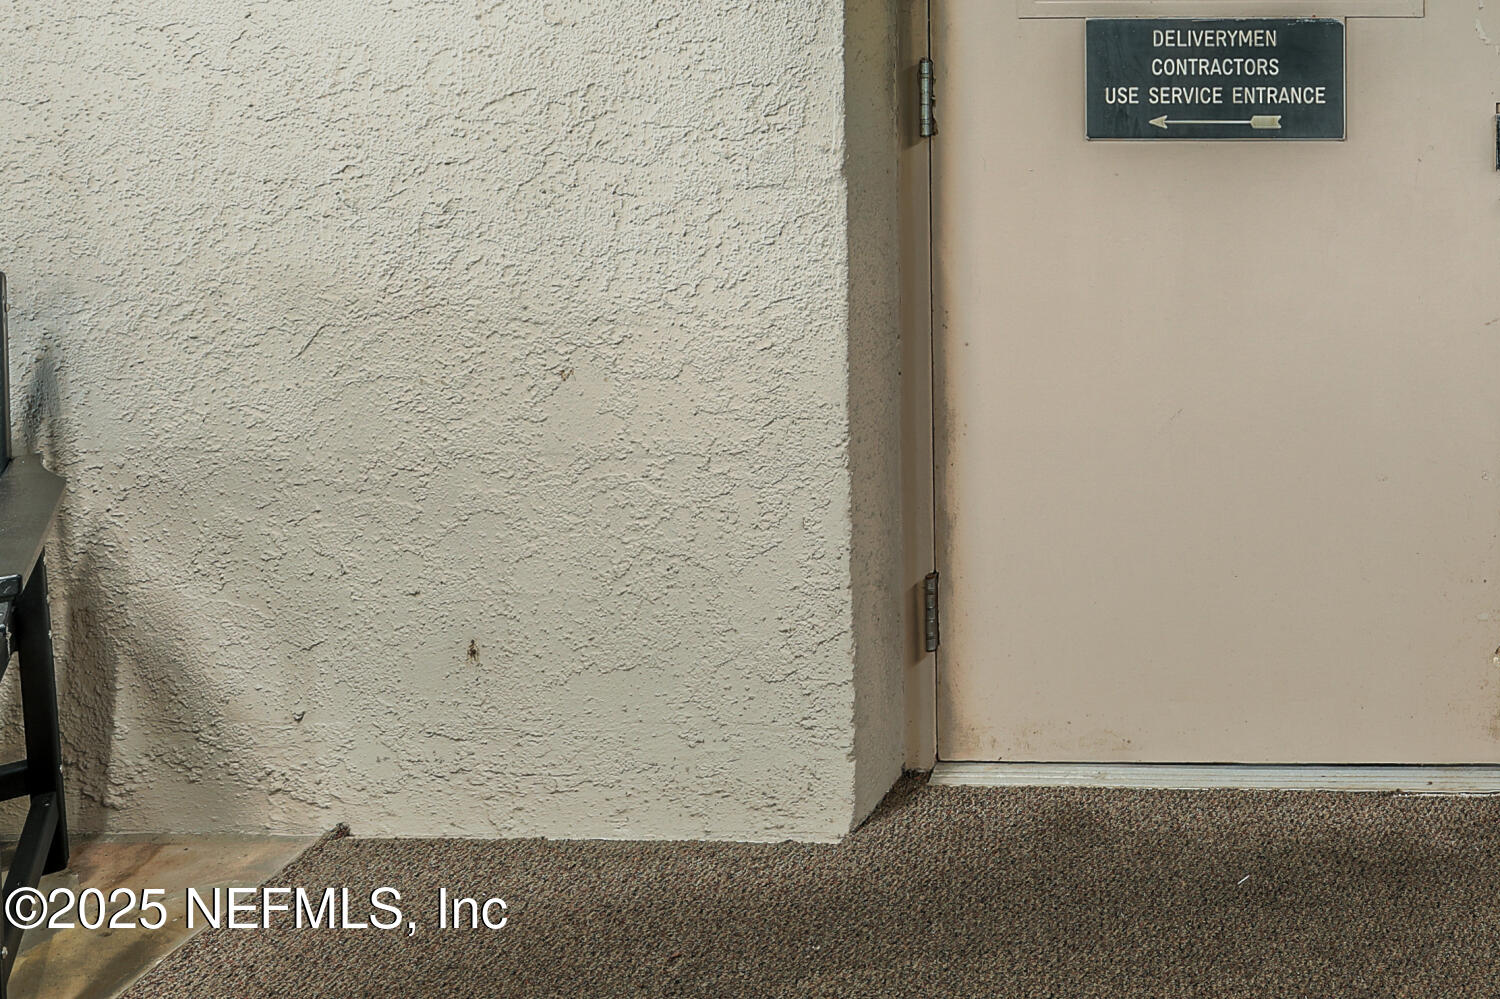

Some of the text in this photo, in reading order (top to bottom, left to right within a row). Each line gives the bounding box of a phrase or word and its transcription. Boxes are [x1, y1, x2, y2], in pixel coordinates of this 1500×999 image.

[1153, 30, 1277, 47] DELIVERYMEN
[1151, 58, 1279, 75] CONTRACTORS
[1105, 87, 1326, 104] USE SERVICE ENTRANCE
